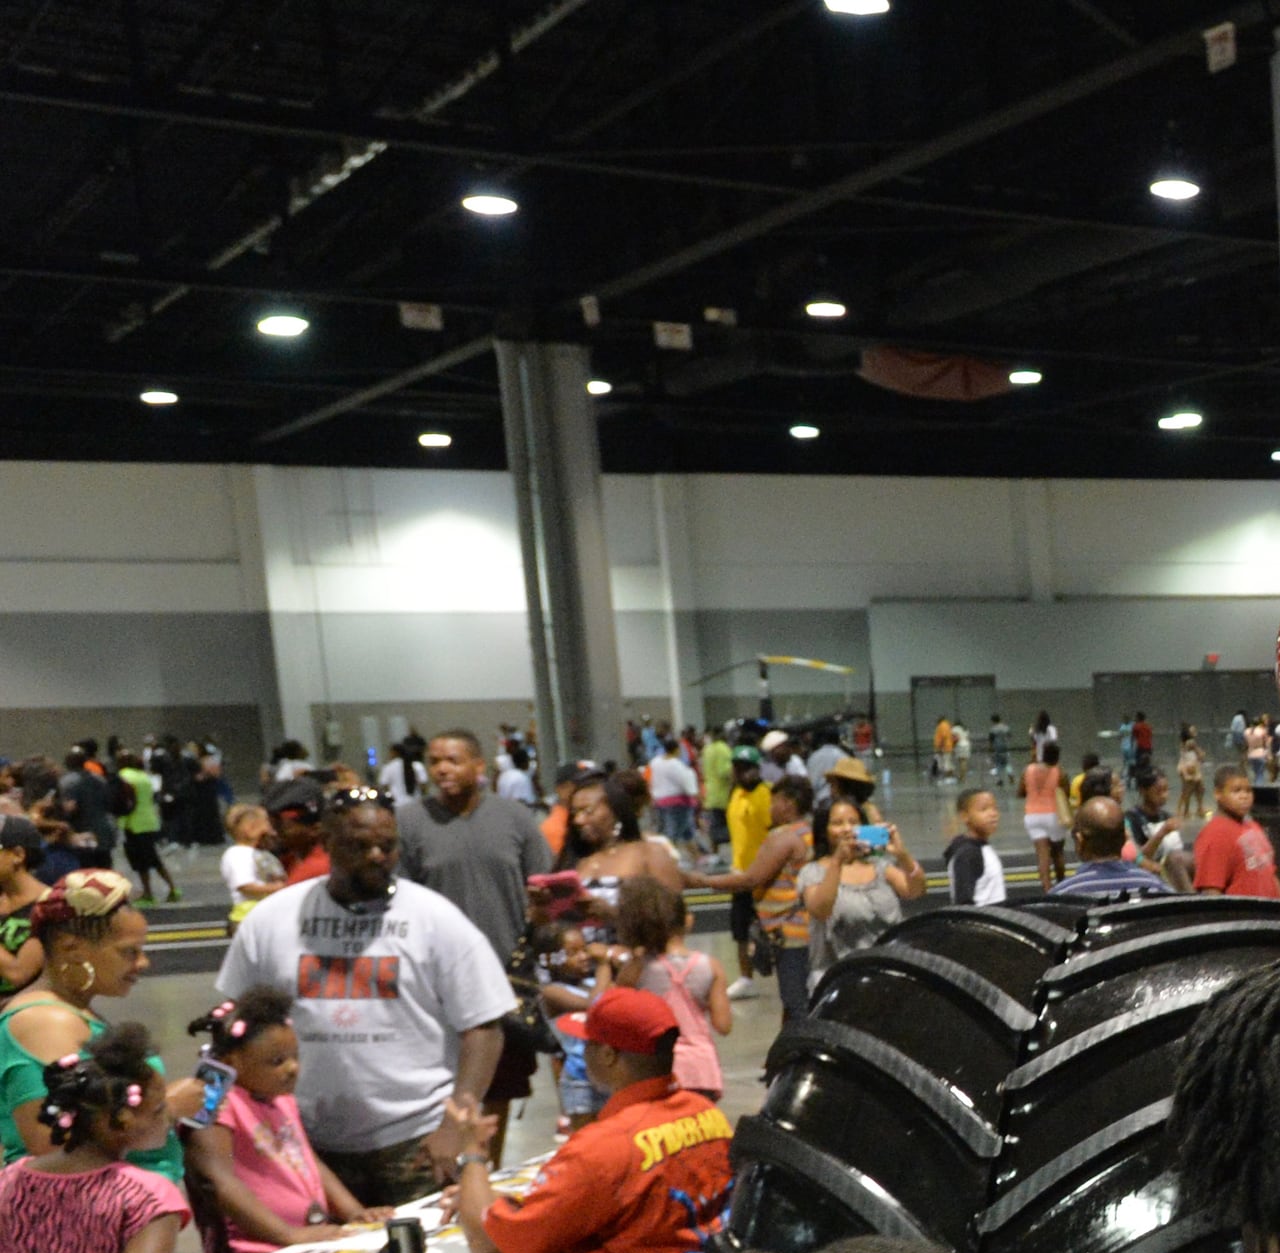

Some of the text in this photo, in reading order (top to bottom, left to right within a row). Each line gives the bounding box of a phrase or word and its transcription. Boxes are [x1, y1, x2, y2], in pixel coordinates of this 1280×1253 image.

[301, 917, 409, 938] ATTEMPTING
[342, 941, 364, 954] TO
[298, 954, 399, 999] CARE
